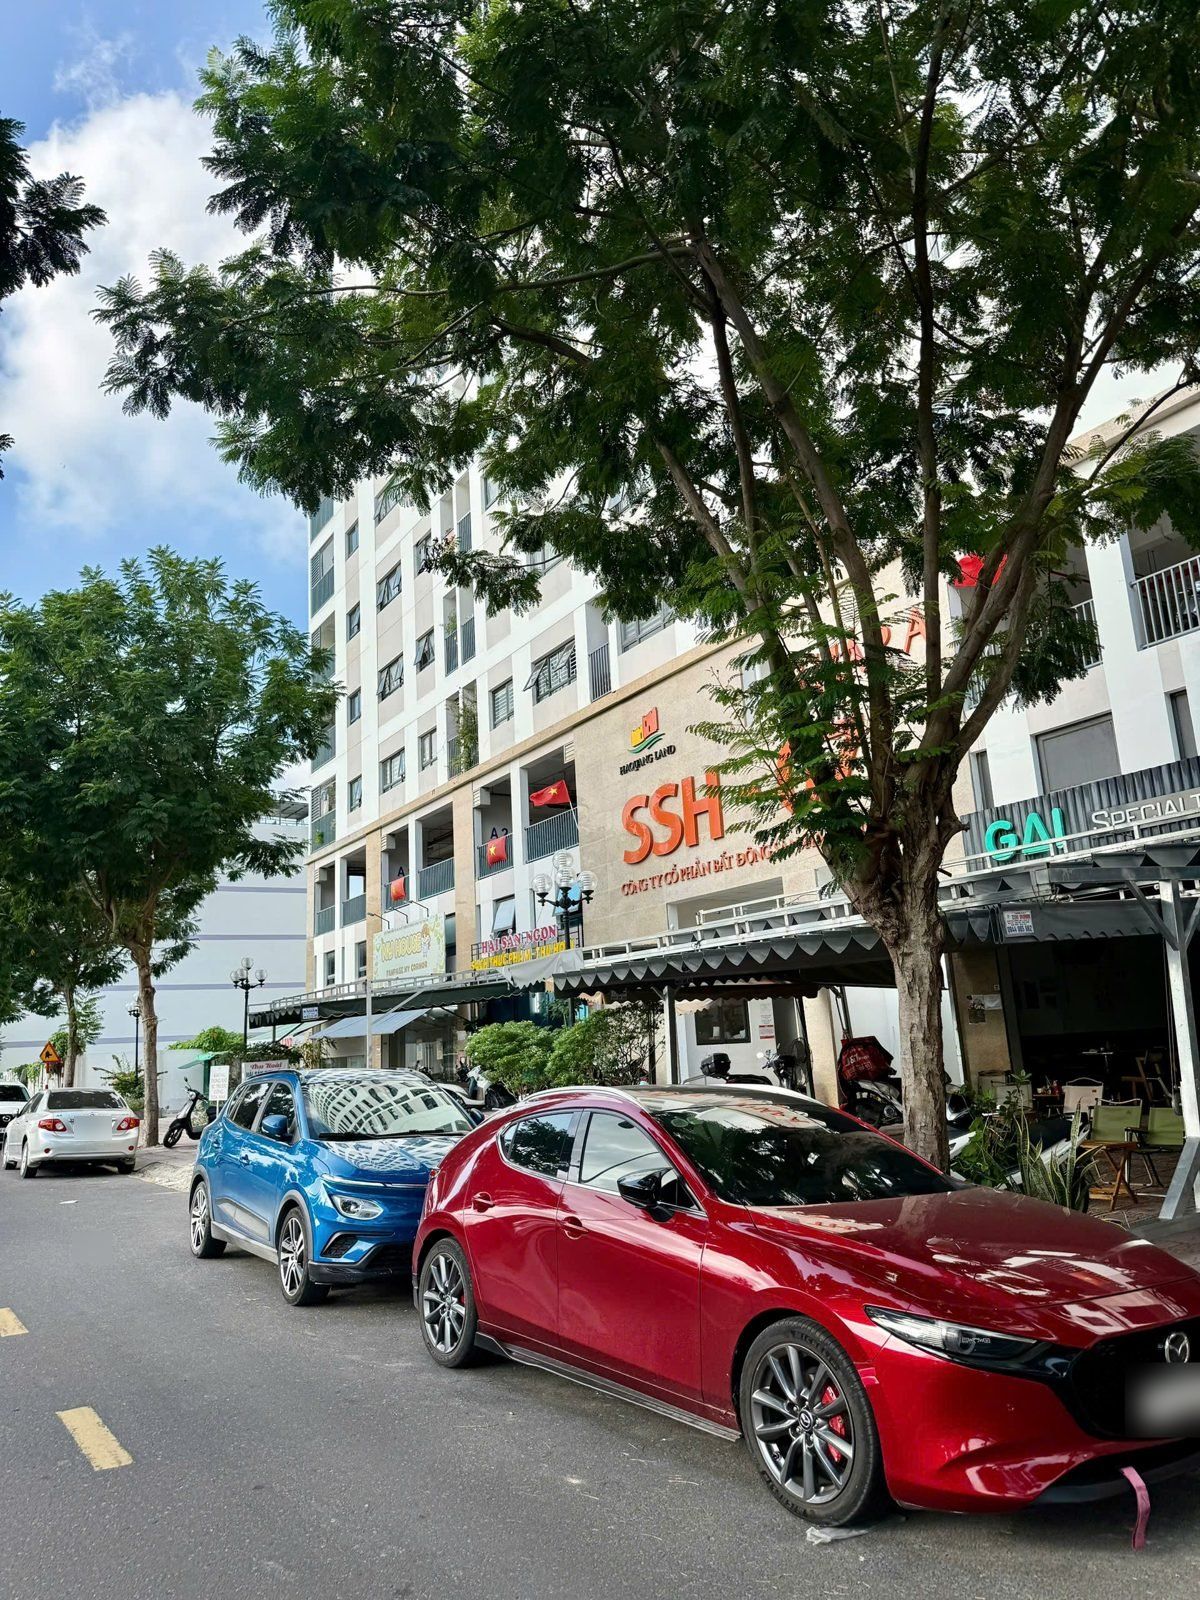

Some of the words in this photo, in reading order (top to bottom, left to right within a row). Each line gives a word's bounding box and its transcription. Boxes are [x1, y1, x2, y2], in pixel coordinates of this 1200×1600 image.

[655, 744, 676, 760] LAND
[621, 770, 725, 865] SSH
[621, 880, 649, 897] CÔNG
[650, 873, 664, 890] TY
[395, 931, 422, 959] HOUSE
